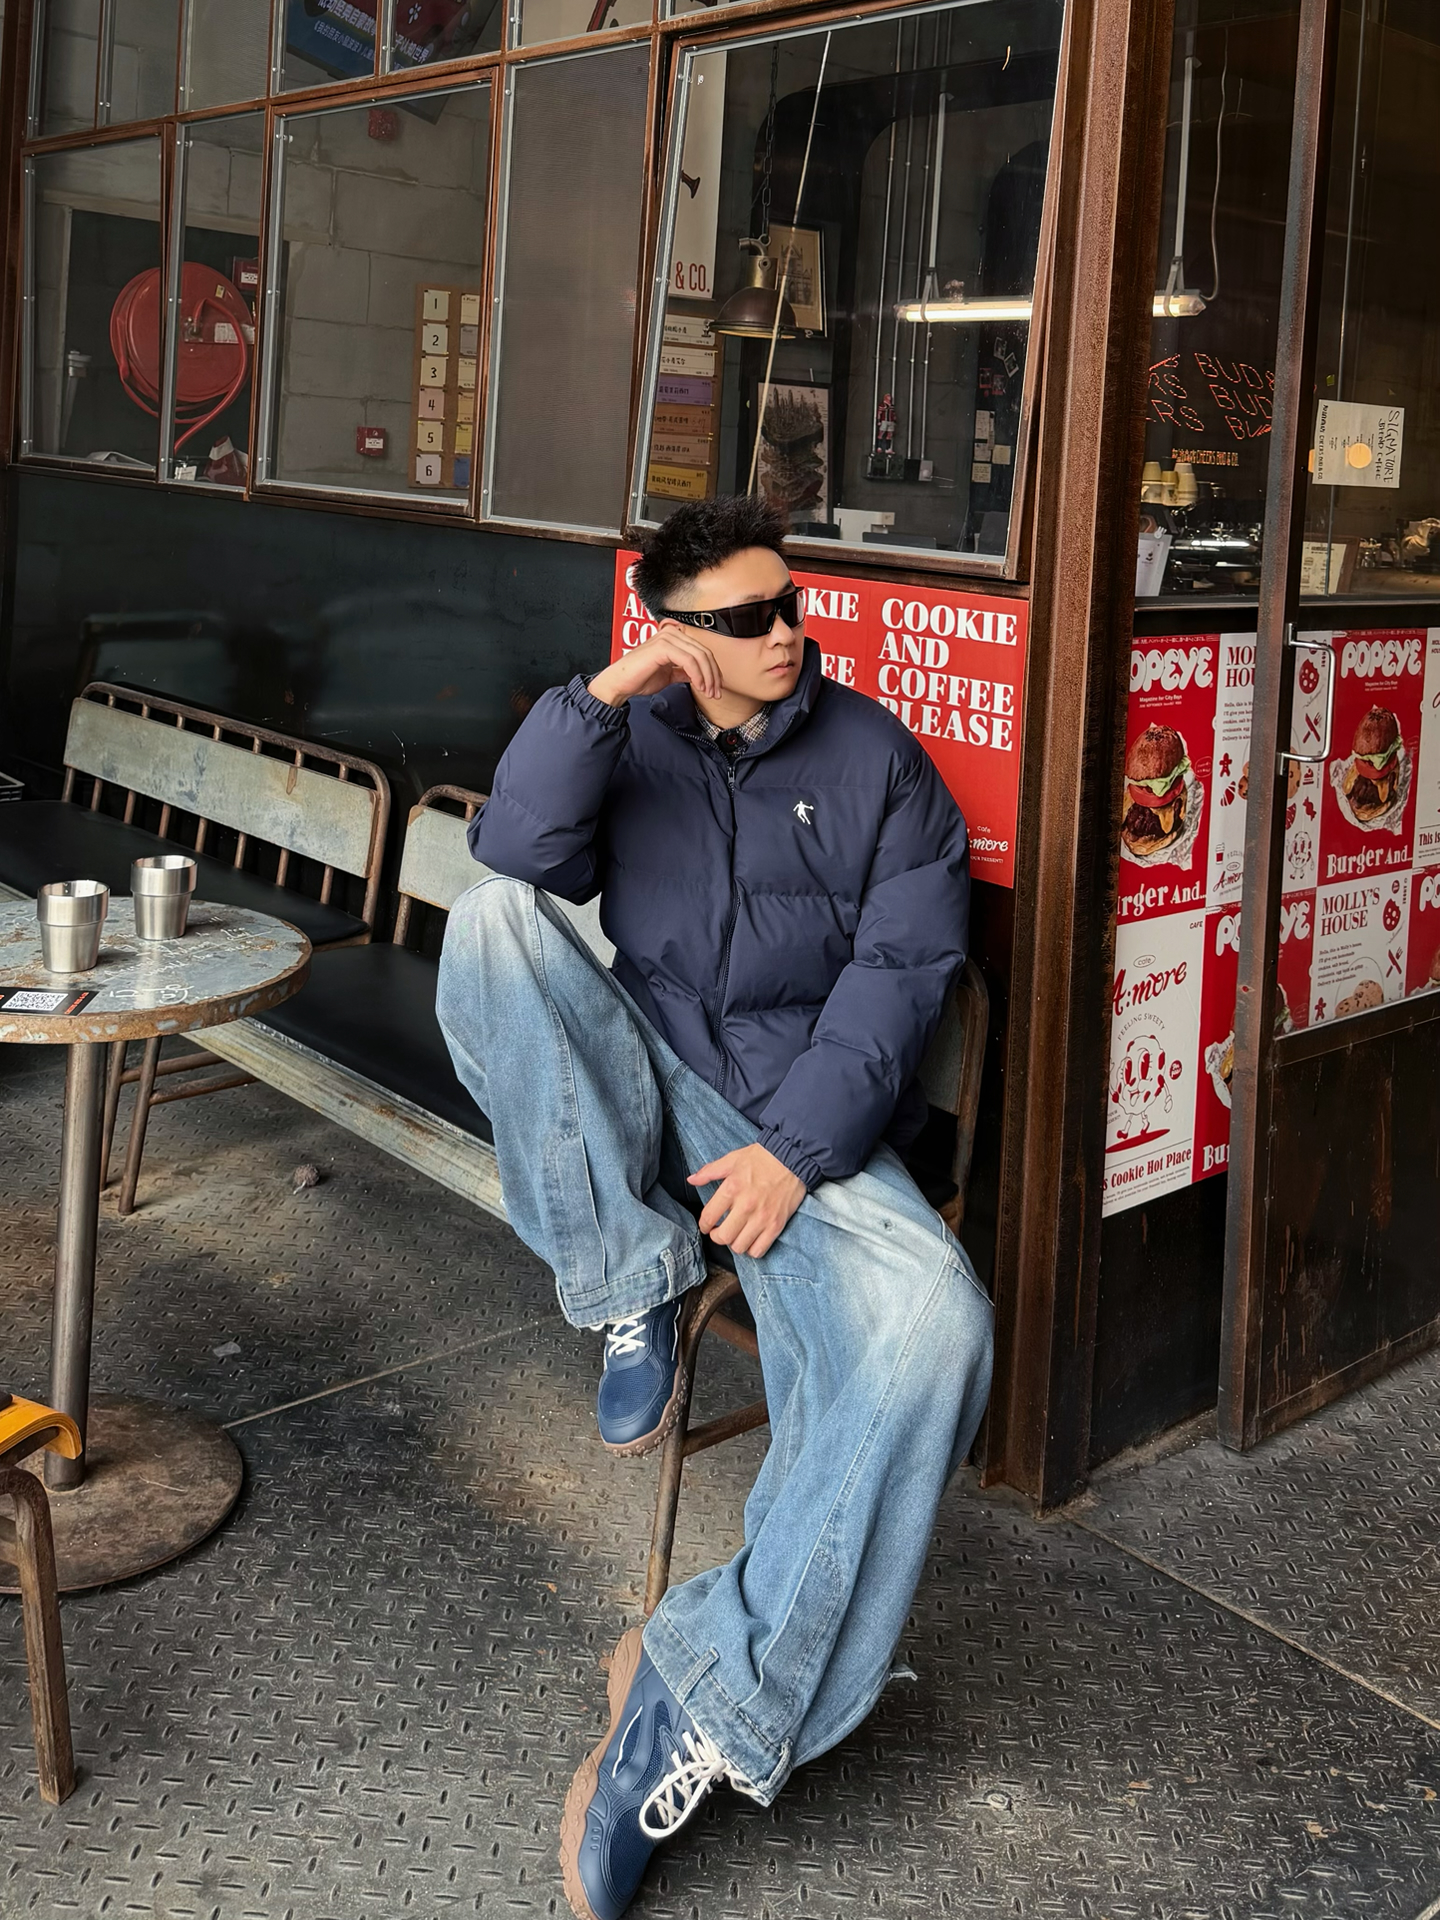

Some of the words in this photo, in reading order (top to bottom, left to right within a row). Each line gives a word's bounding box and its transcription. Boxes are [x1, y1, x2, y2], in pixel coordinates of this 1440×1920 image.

[395, 32, 430, 64] 子认知世界
[675, 260, 685, 290] &
[689, 263, 710, 293] CO.
[432, 335, 439, 346] 2
[430, 367, 437, 379] 3
[1194, 352, 1263, 390] BUD
[428, 399, 435, 411] 4
[427, 432, 434, 443] 5
[425, 465, 433, 477] 6
[803, 587, 859, 622] KIE
[881, 597, 1018, 646] COOKIE
[878, 631, 950, 669] AND
[1340, 638, 1422, 679] POPEYE
[1129, 646, 1214, 693] OPEYE
[877, 664, 1015, 717] COFFEE
[967, 834, 1009, 852] :more
[1419, 832, 1433, 847] This
[1326, 845, 1384, 879] Burger
[1116, 883, 1169, 917] rger
[1321, 887, 1381, 916] MOLLY'S
[1320, 909, 1369, 937] HOUSE
[1111, 1165, 1145, 1188] Cookie
[1147, 1156, 1163, 1176] Hot
[1165, 1148, 1192, 1169] Place
